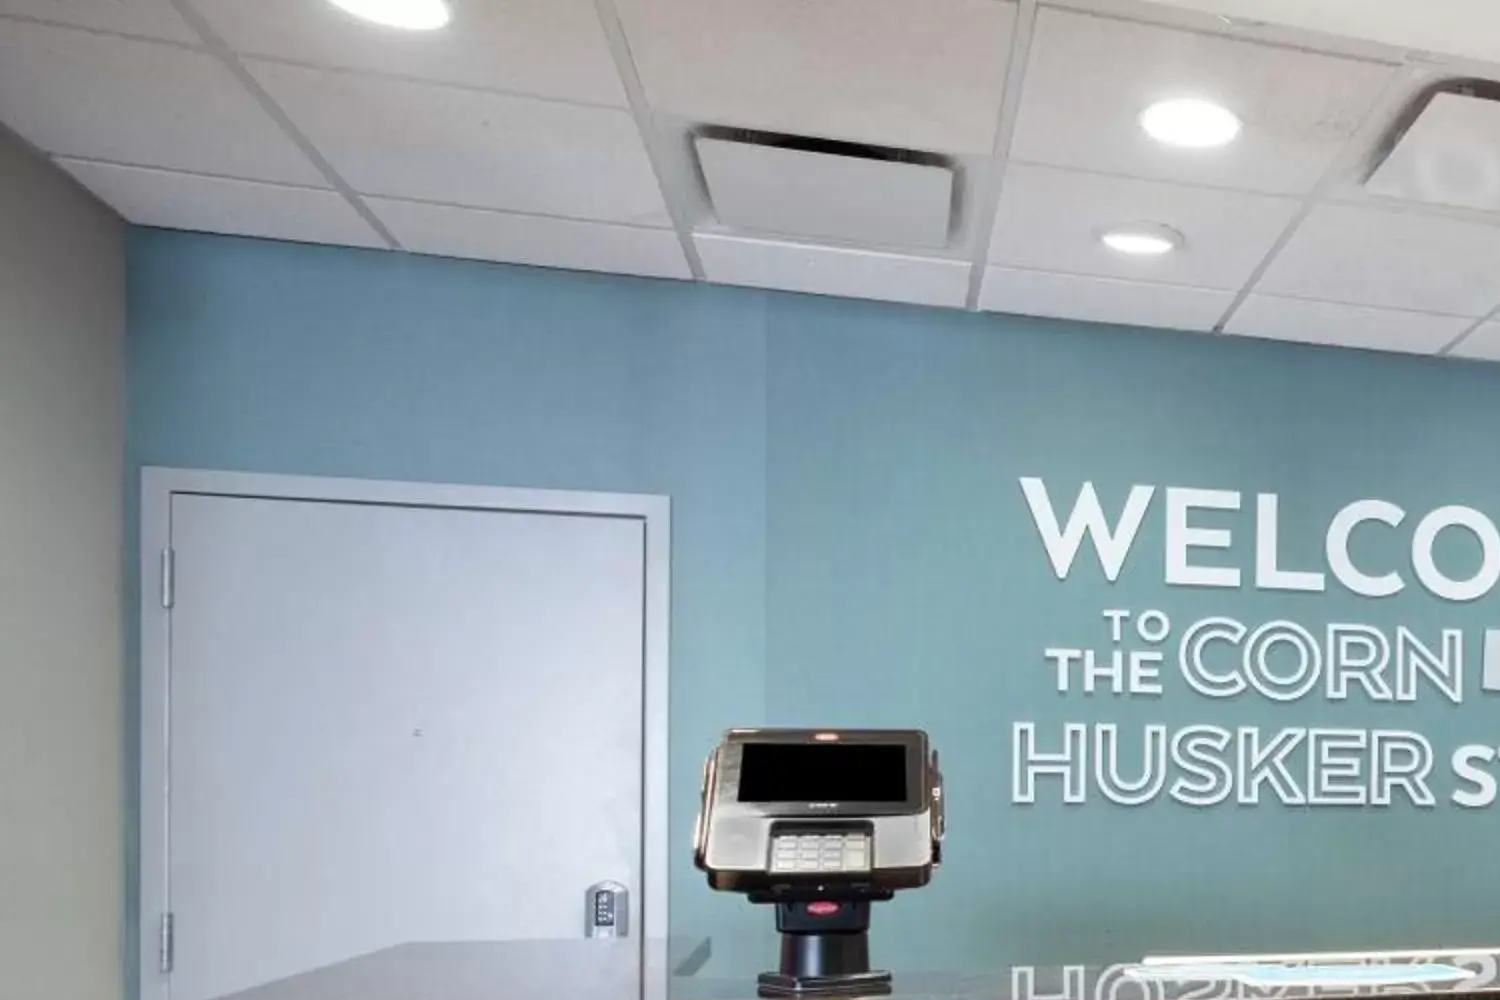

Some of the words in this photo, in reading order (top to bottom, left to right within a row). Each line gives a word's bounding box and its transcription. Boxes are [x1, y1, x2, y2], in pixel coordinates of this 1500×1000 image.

[1045, 648, 1163, 694] THE
[1178, 616, 1463, 703] CORN
[1103, 609, 1170, 642] TO
[1011, 721, 1436, 806] HUSKER
